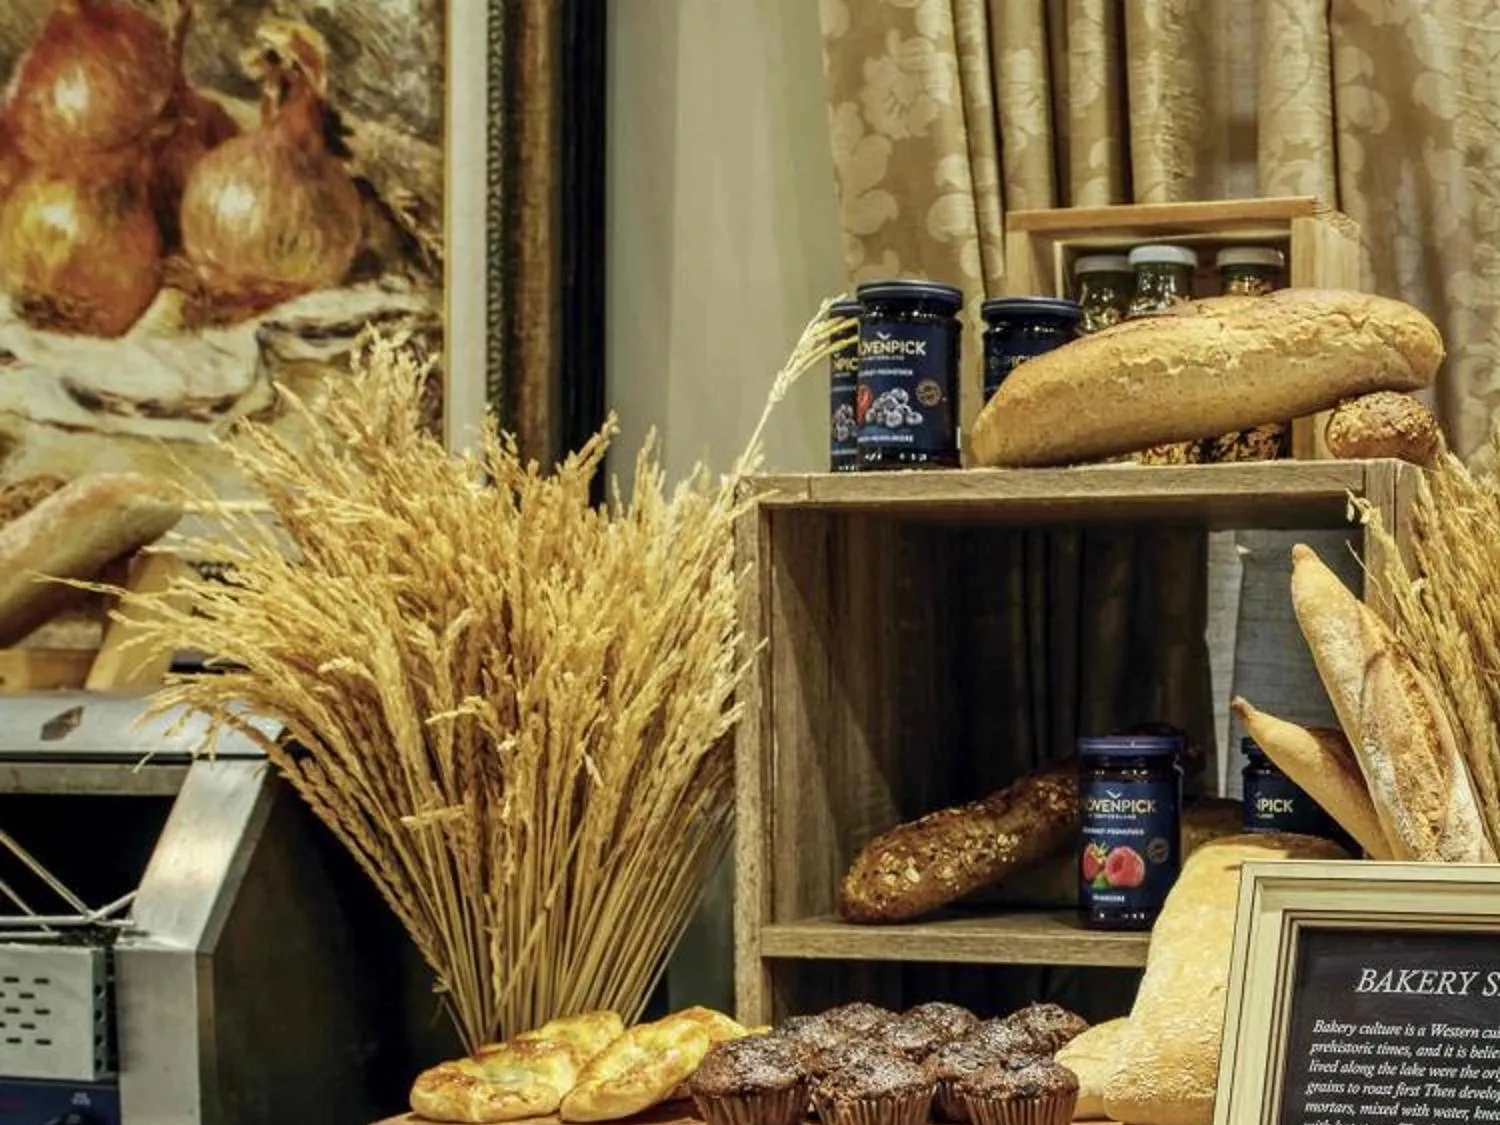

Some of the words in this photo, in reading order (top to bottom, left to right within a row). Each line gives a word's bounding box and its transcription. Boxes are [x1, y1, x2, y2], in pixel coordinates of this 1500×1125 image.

[1355, 967, 1479, 996] BAKERY
[1312, 1020, 1357, 1037] Bakery
[1358, 1021, 1403, 1036] culture
[1405, 1023, 1415, 1037] is
[1417, 1026, 1427, 1037] a
[1431, 1023, 1479, 1038] Western
[1309, 1040, 1375, 1055] prehistoric
[1376, 1041, 1413, 1058] times,
[1415, 1043, 1441, 1057] and
[1444, 1045, 1454, 1057] it
[1456, 1047, 1467, 1058] is
[1309, 1060, 1340, 1073] lived
[1340, 1061, 1375, 1078] along
[1377, 1063, 1398, 1075] the
[1400, 1063, 1427, 1076] lake
[1429, 1066, 1458, 1078] were
[1459, 1064, 1480, 1078] the
[1305, 1081, 1345, 1096] grains
[1347, 1084, 1359, 1094] to
[1362, 1085, 1394, 1095] roast
[1391, 1082, 1421, 1098] first
[1423, 1083, 1457, 1098] Then
[1304, 1102, 1356, 1116] mortars,
[1359, 1102, 1400, 1116] mixed
[1401, 1104, 1431, 1117] with
[1433, 1106, 1470, 1121] water,
